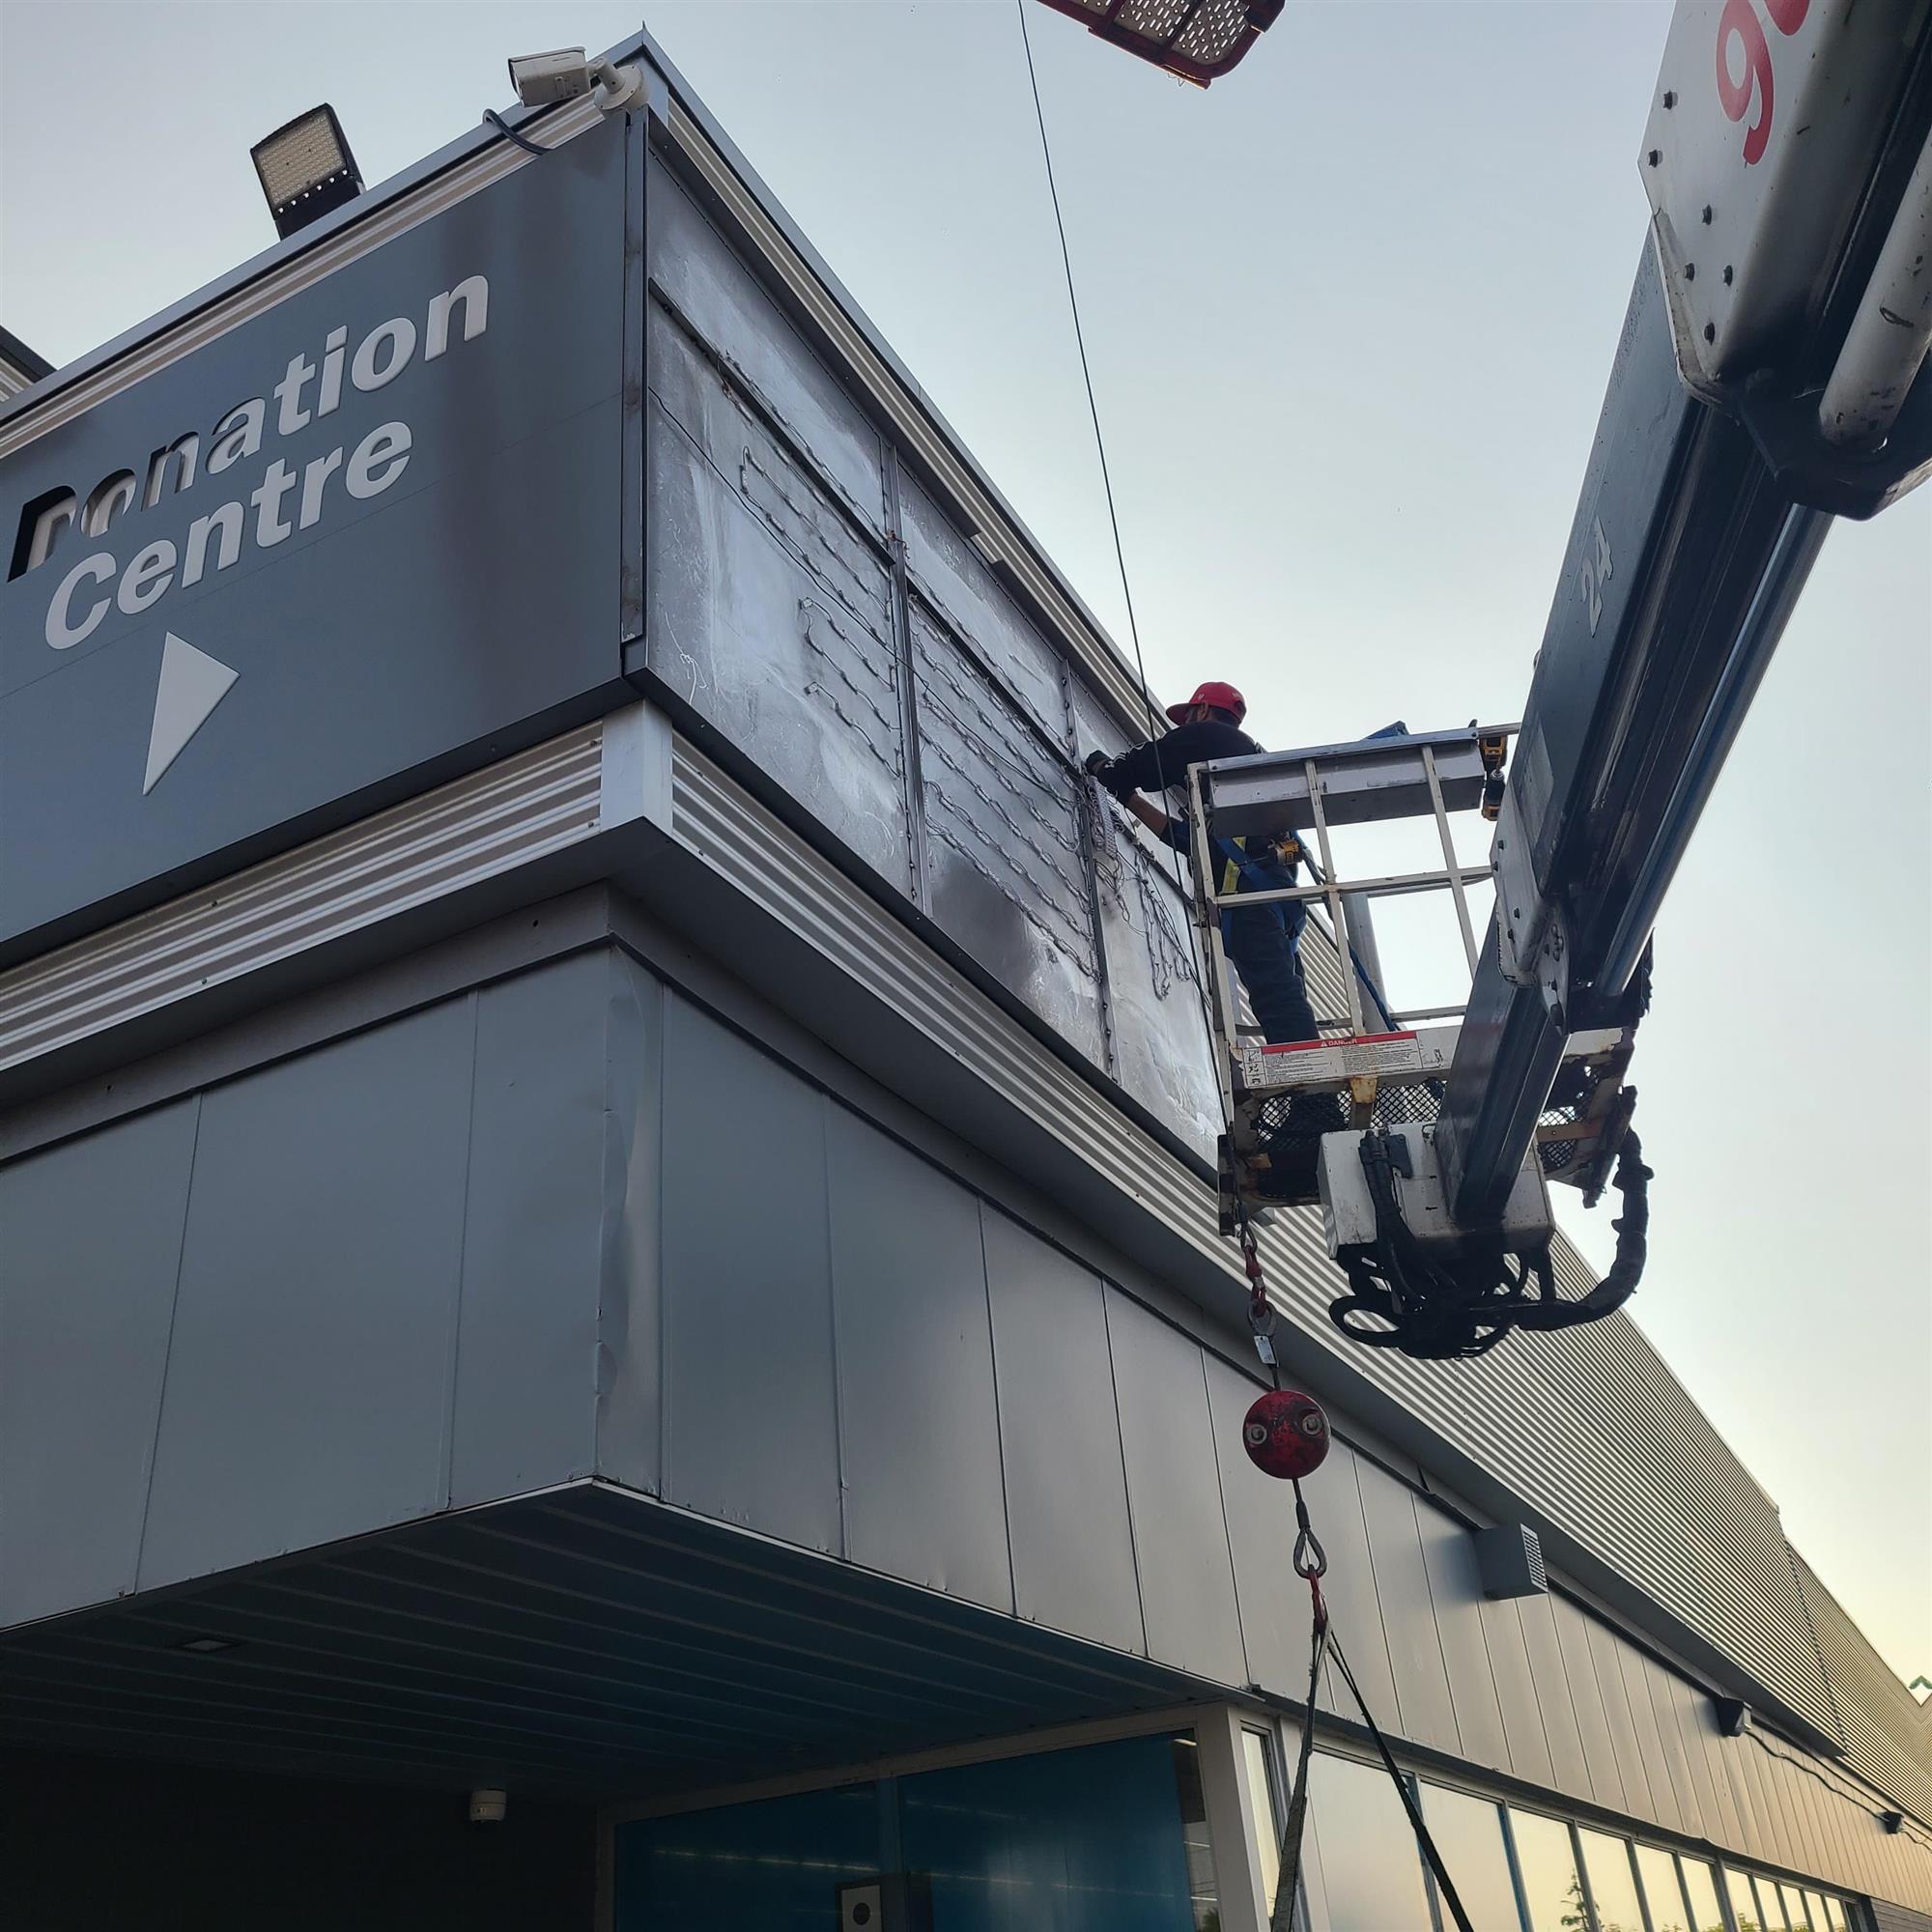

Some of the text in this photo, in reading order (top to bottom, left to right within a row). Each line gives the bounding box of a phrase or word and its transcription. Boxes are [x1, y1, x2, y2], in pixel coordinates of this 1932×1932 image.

[1716, 0, 1811, 166] 9
[44, 421, 412, 651] Centre
[1581, 514, 1614, 639] 24
